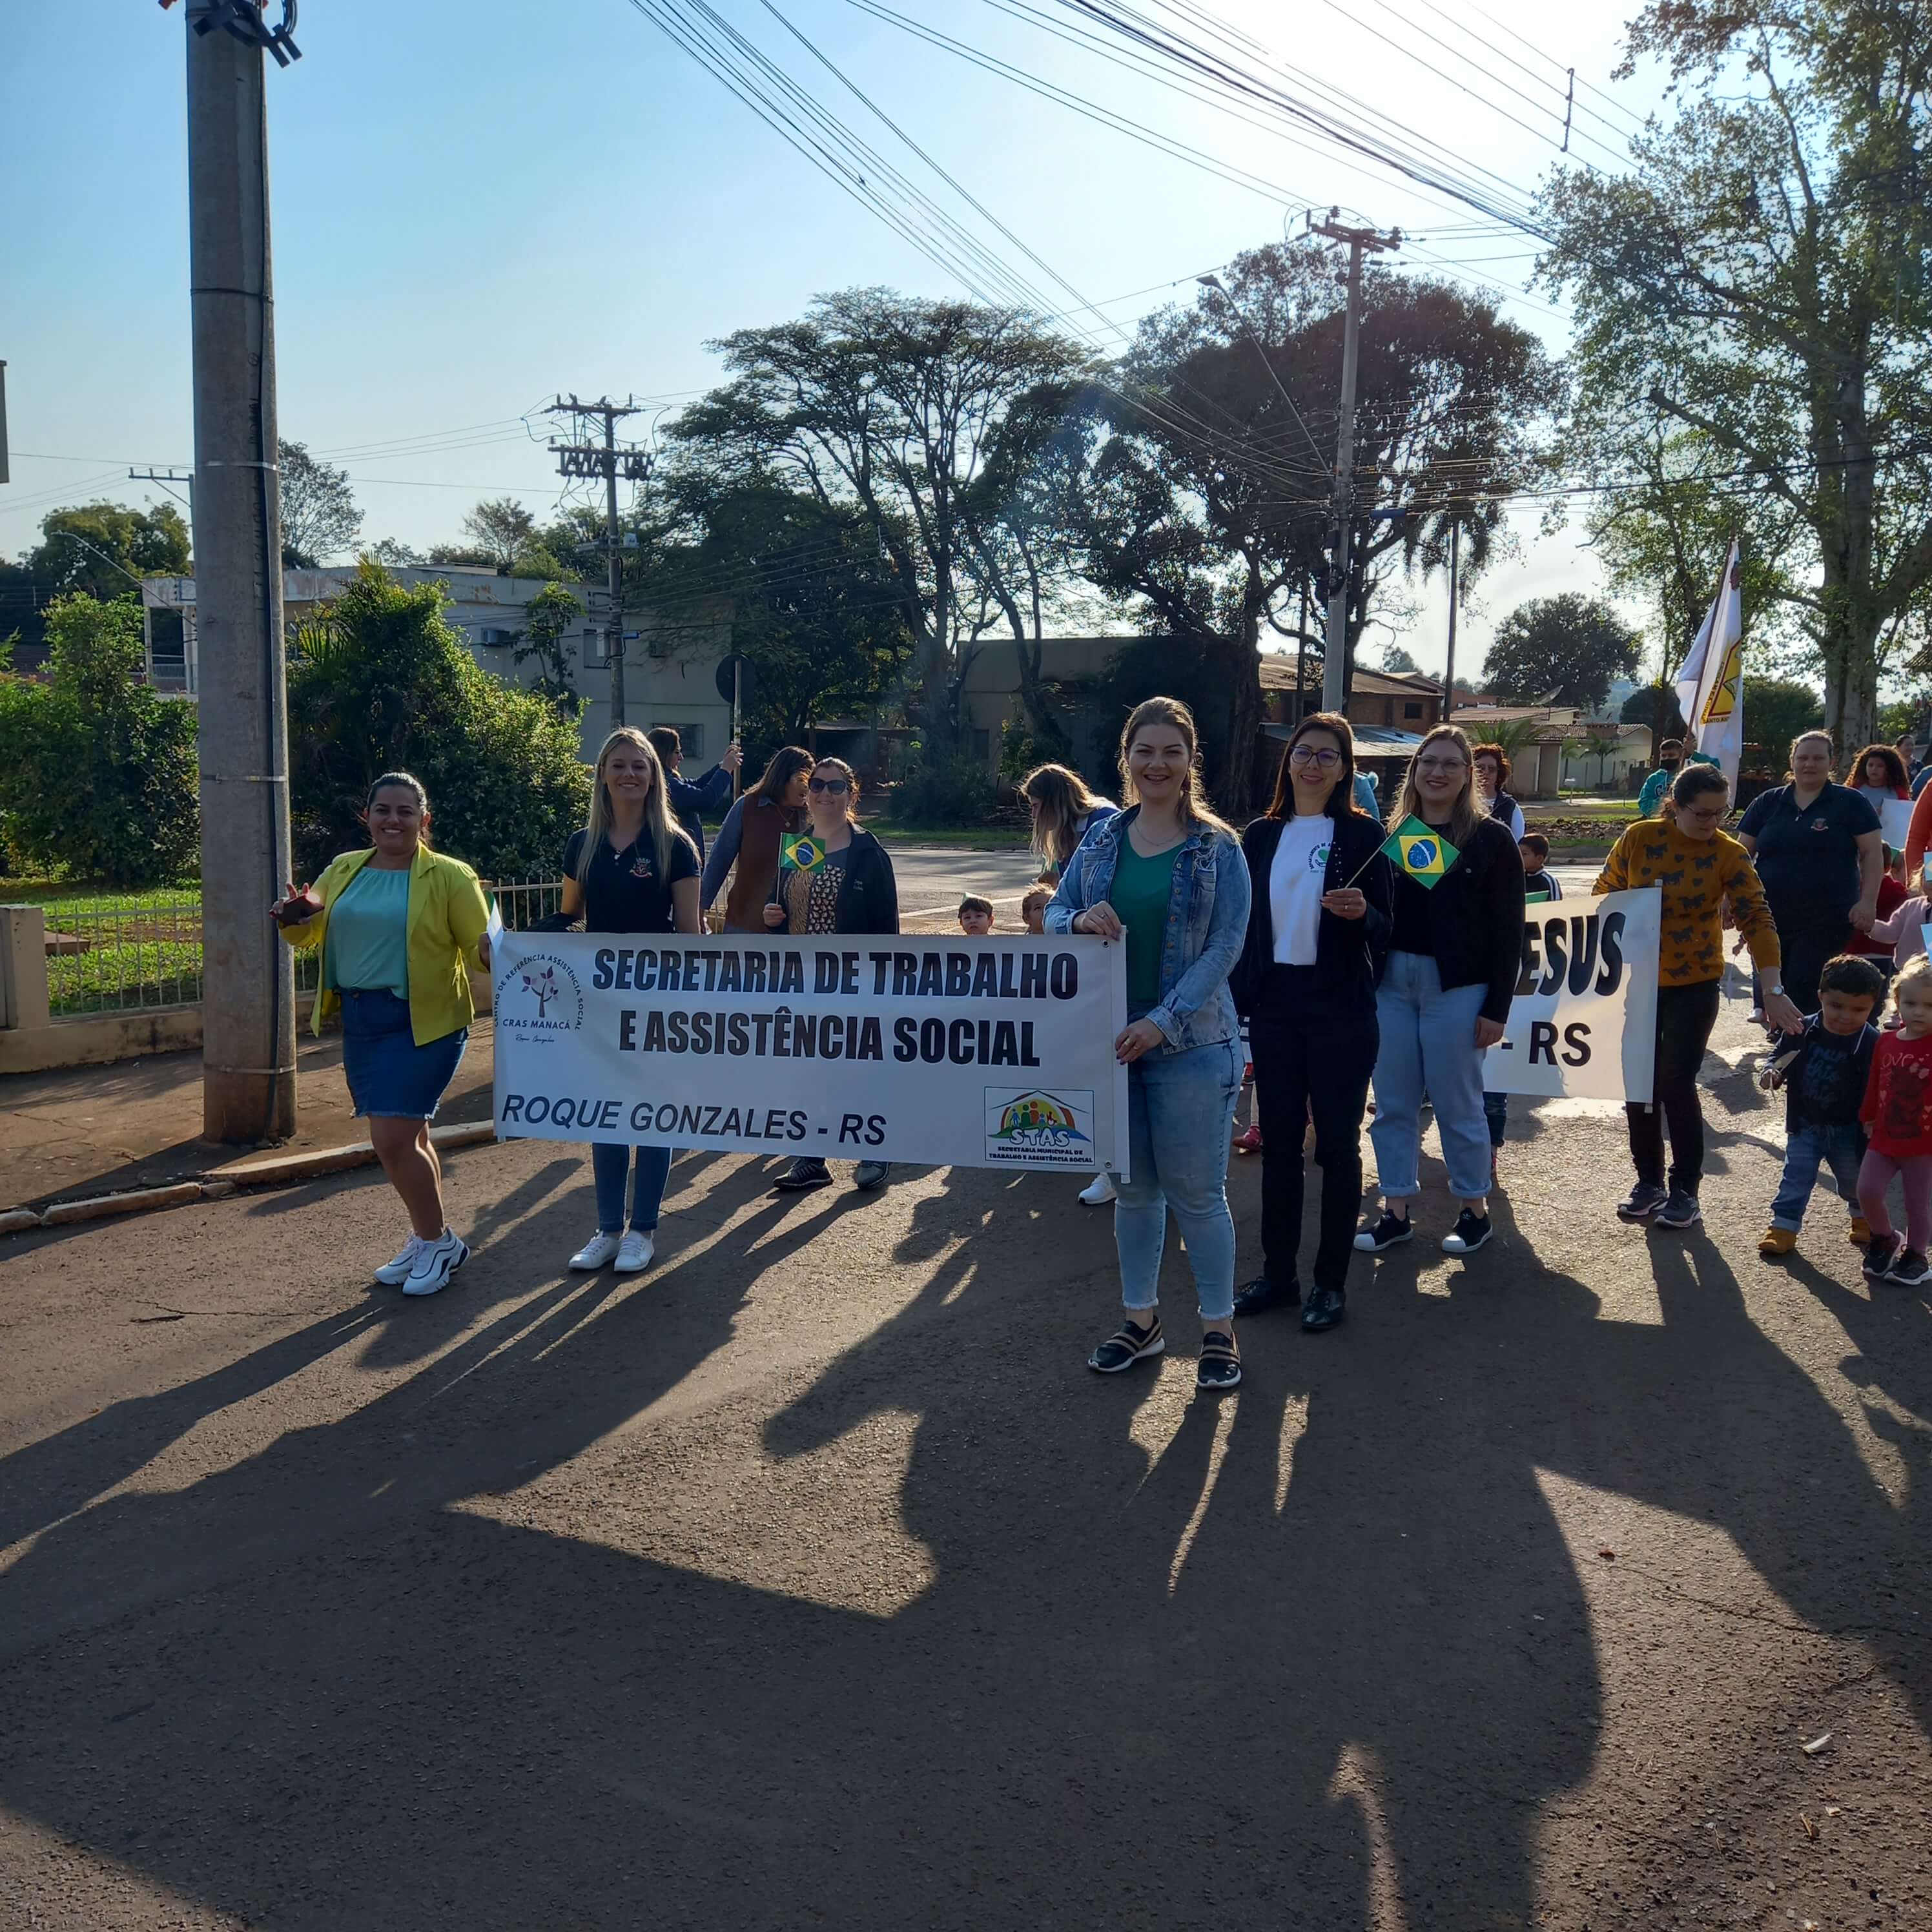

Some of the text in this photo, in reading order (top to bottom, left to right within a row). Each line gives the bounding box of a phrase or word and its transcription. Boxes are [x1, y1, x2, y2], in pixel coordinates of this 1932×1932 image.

[498, 980, 507, 991] DE
[505, 954, 545, 981] REFERÊNCIA
[548, 955, 581, 996] ASSISTÊNCIA
[575, 998, 584, 1031] SOCIAL
[593, 949, 1078, 1000] SECRETARIA DE TRABALHO
[502, 1018, 570, 1029] CRAS MANACÁ
[619, 1005, 1040, 1067] E ASSISTÊNCIA SOCIAL
[1528, 1021, 1592, 1067] RS
[501, 1094, 622, 1129] ROQUE
[630, 1102, 808, 1140] GONZALES
[839, 1113, 887, 1146] RS
[1009, 1125, 1070, 1147] STAS
[1028, 1154, 1068, 1163] ASSISTÊNCIA
